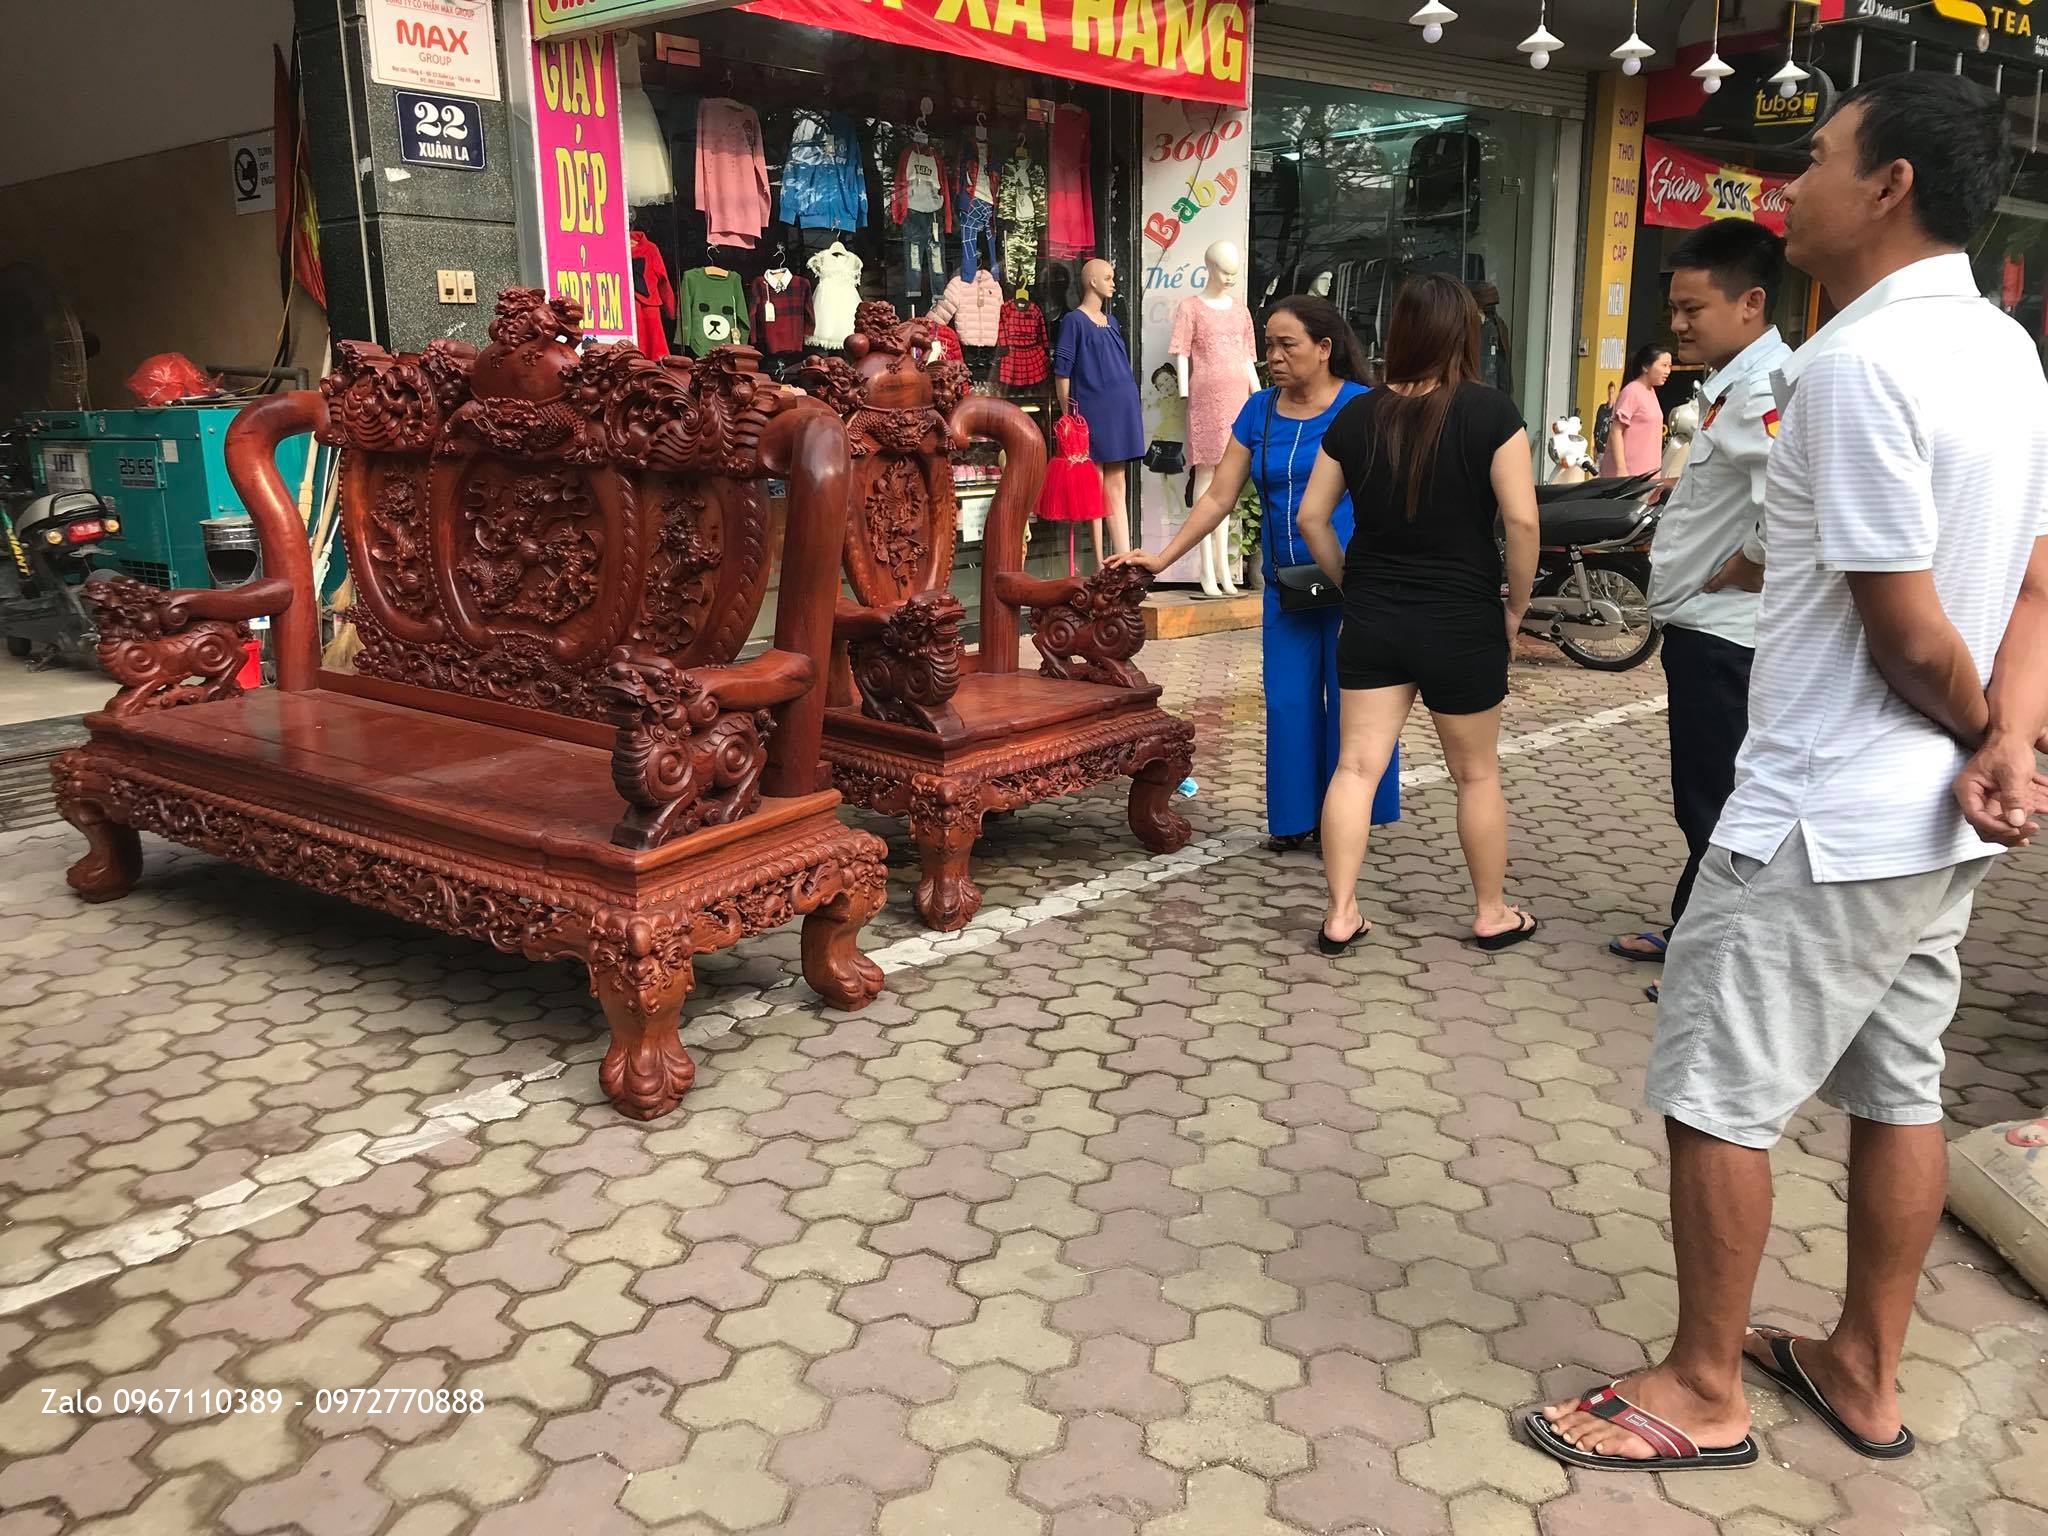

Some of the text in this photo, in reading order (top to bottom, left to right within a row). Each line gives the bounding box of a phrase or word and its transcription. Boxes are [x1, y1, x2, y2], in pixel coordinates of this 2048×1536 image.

[1899, 9, 1911, 25] La
[1991, 6, 2031, 37] TEA
[396, 19, 469, 55] MAX
[418, 52, 452, 66] GROUP
[414, 101, 468, 141] 22
[1618, 107, 1639, 128] SHOP
[418, 141, 470, 162] XUÂN LA
[555, 122, 608, 236] DÉP
[1611, 176, 1636, 197] TRANG
[1650, 156, 1704, 214] Giảm
[1144, 167, 1240, 251] Baby
[1613, 210, 1629, 230] CAO
[1146, 263, 1191, 289] Thế
[594, 271, 624, 330] EM
[52, 453, 76, 473] IHI
